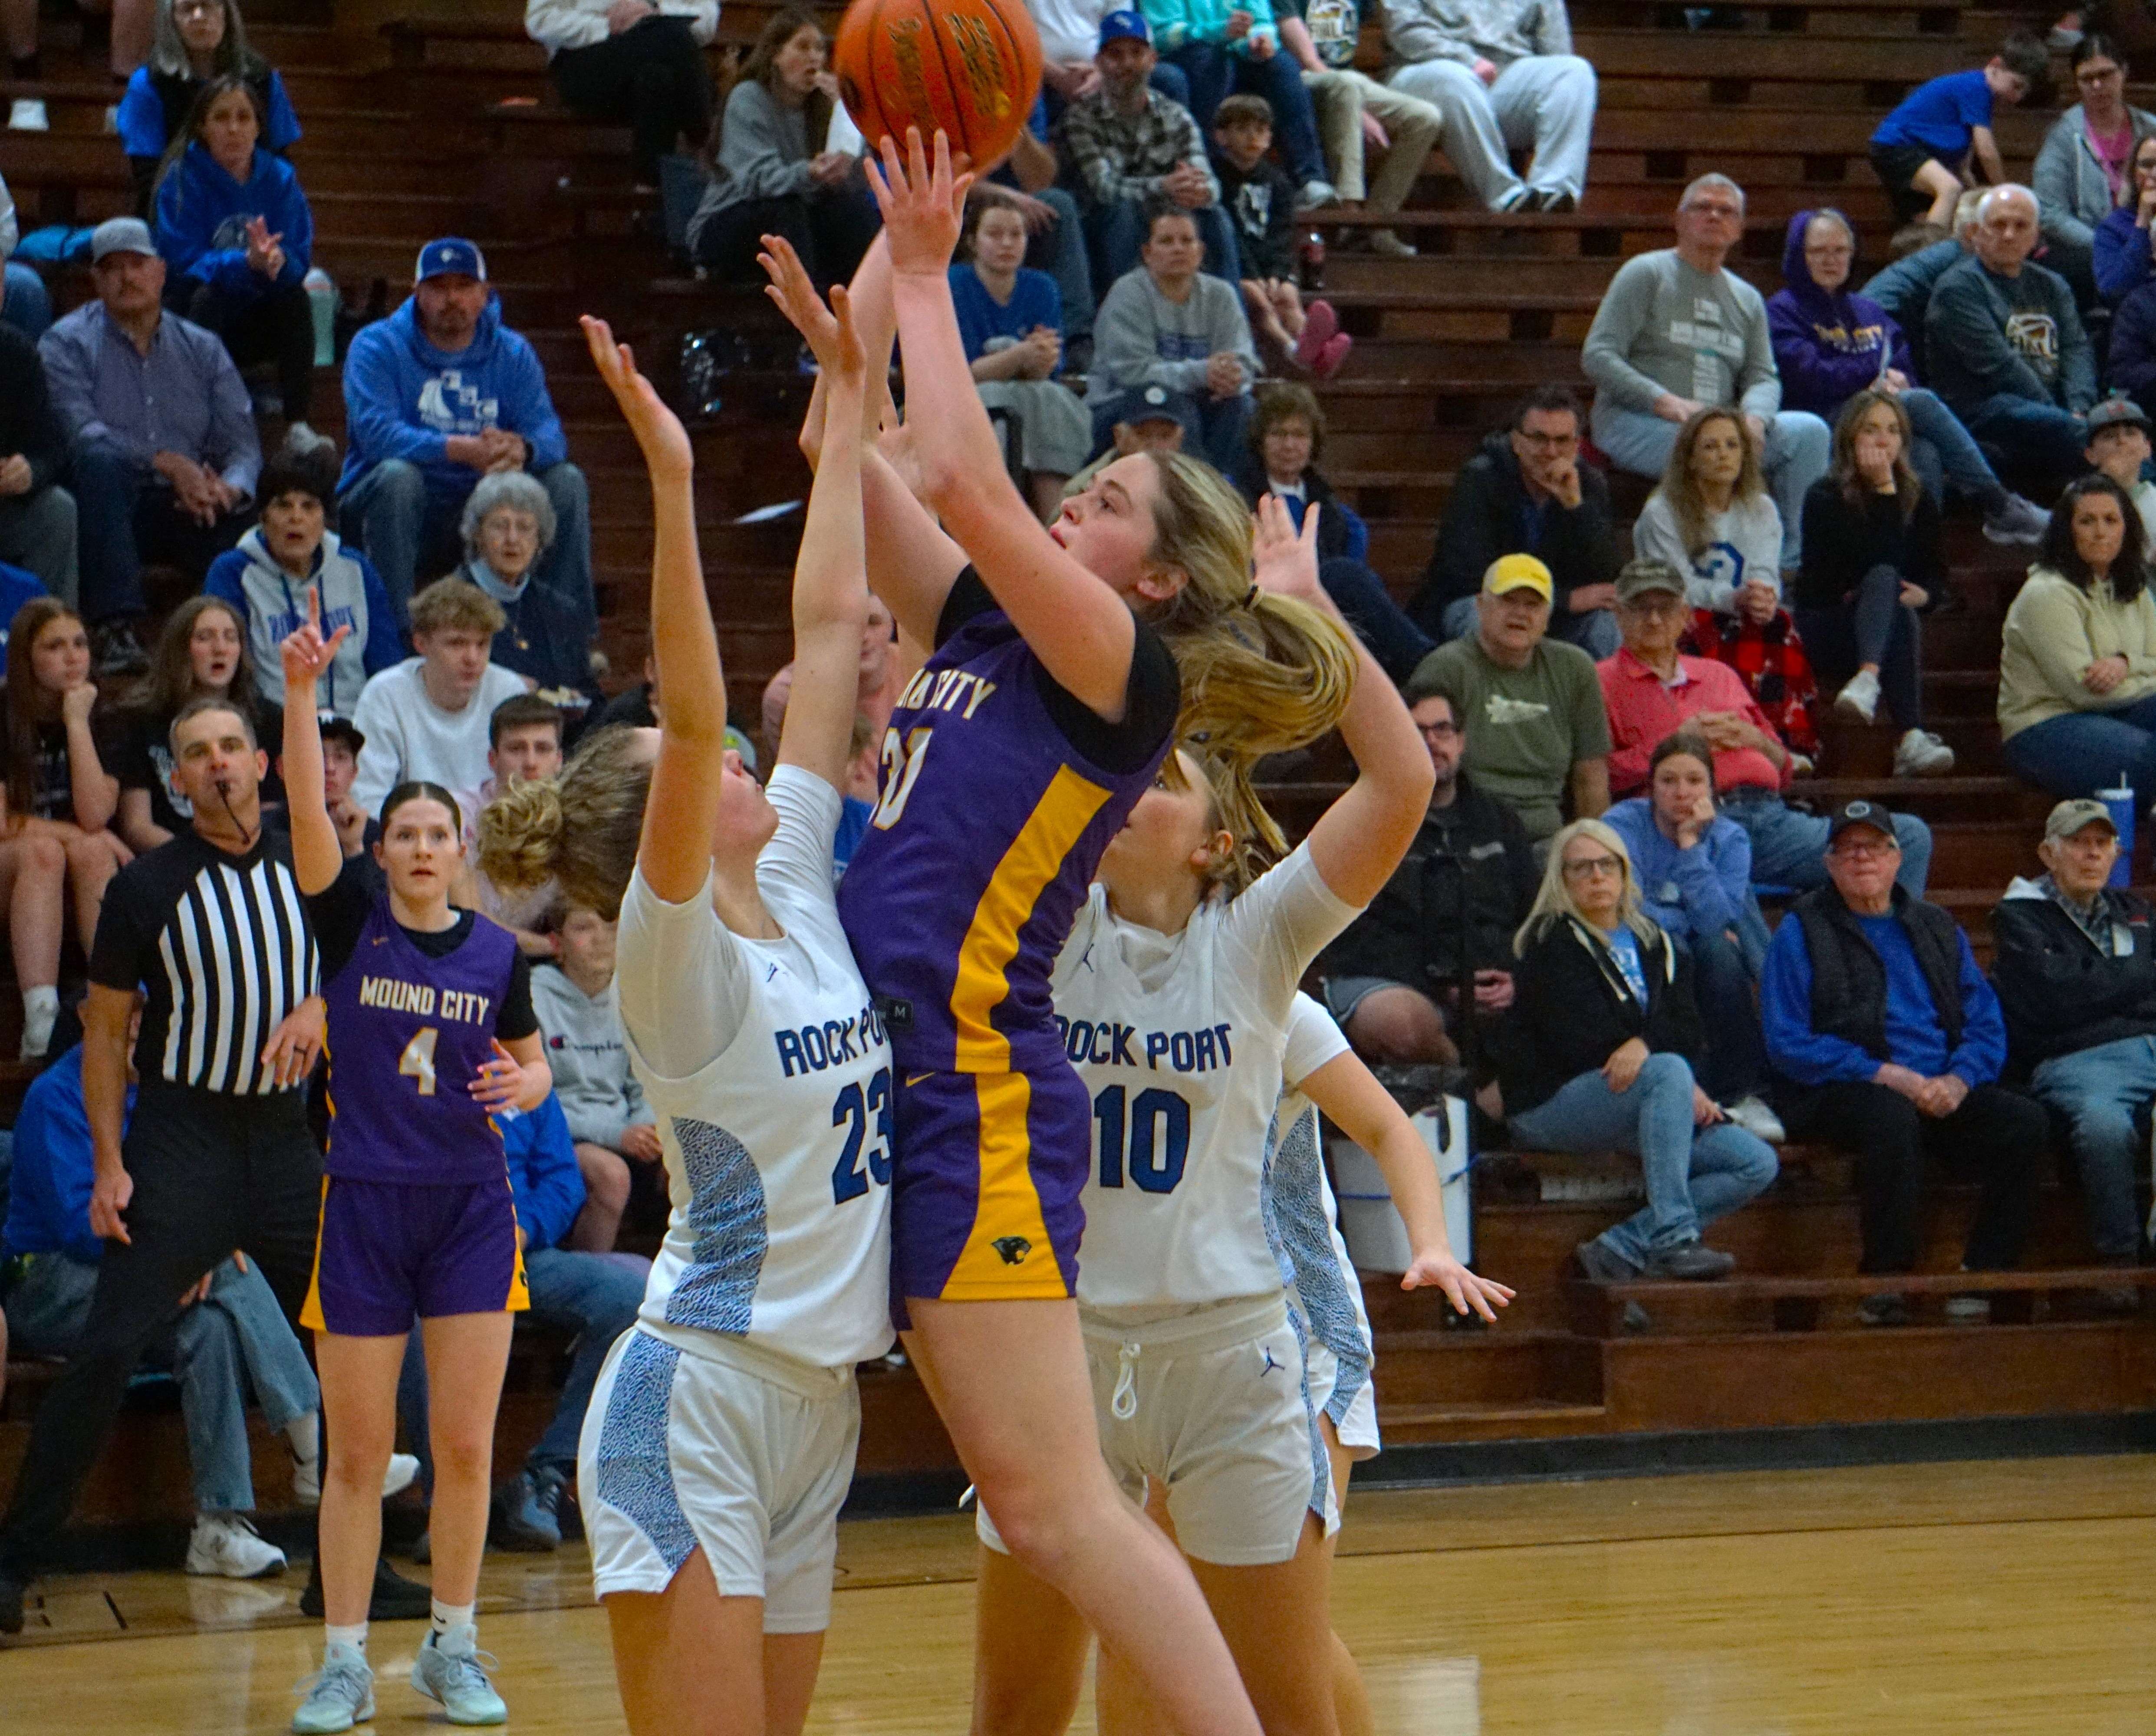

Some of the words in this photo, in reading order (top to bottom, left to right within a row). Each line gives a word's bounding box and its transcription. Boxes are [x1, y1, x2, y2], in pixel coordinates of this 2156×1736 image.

[359, 974, 435, 1016] MOUND
[440, 989, 489, 1026] CITY
[894, 1005, 906, 1018] M
[398, 1025, 438, 1095] 4
[774, 1017, 858, 1078] ROCK
[1146, 1023, 1231, 1072] PORT
[832, 1066, 892, 1205] 23
[1093, 1084, 1191, 1194] 10
